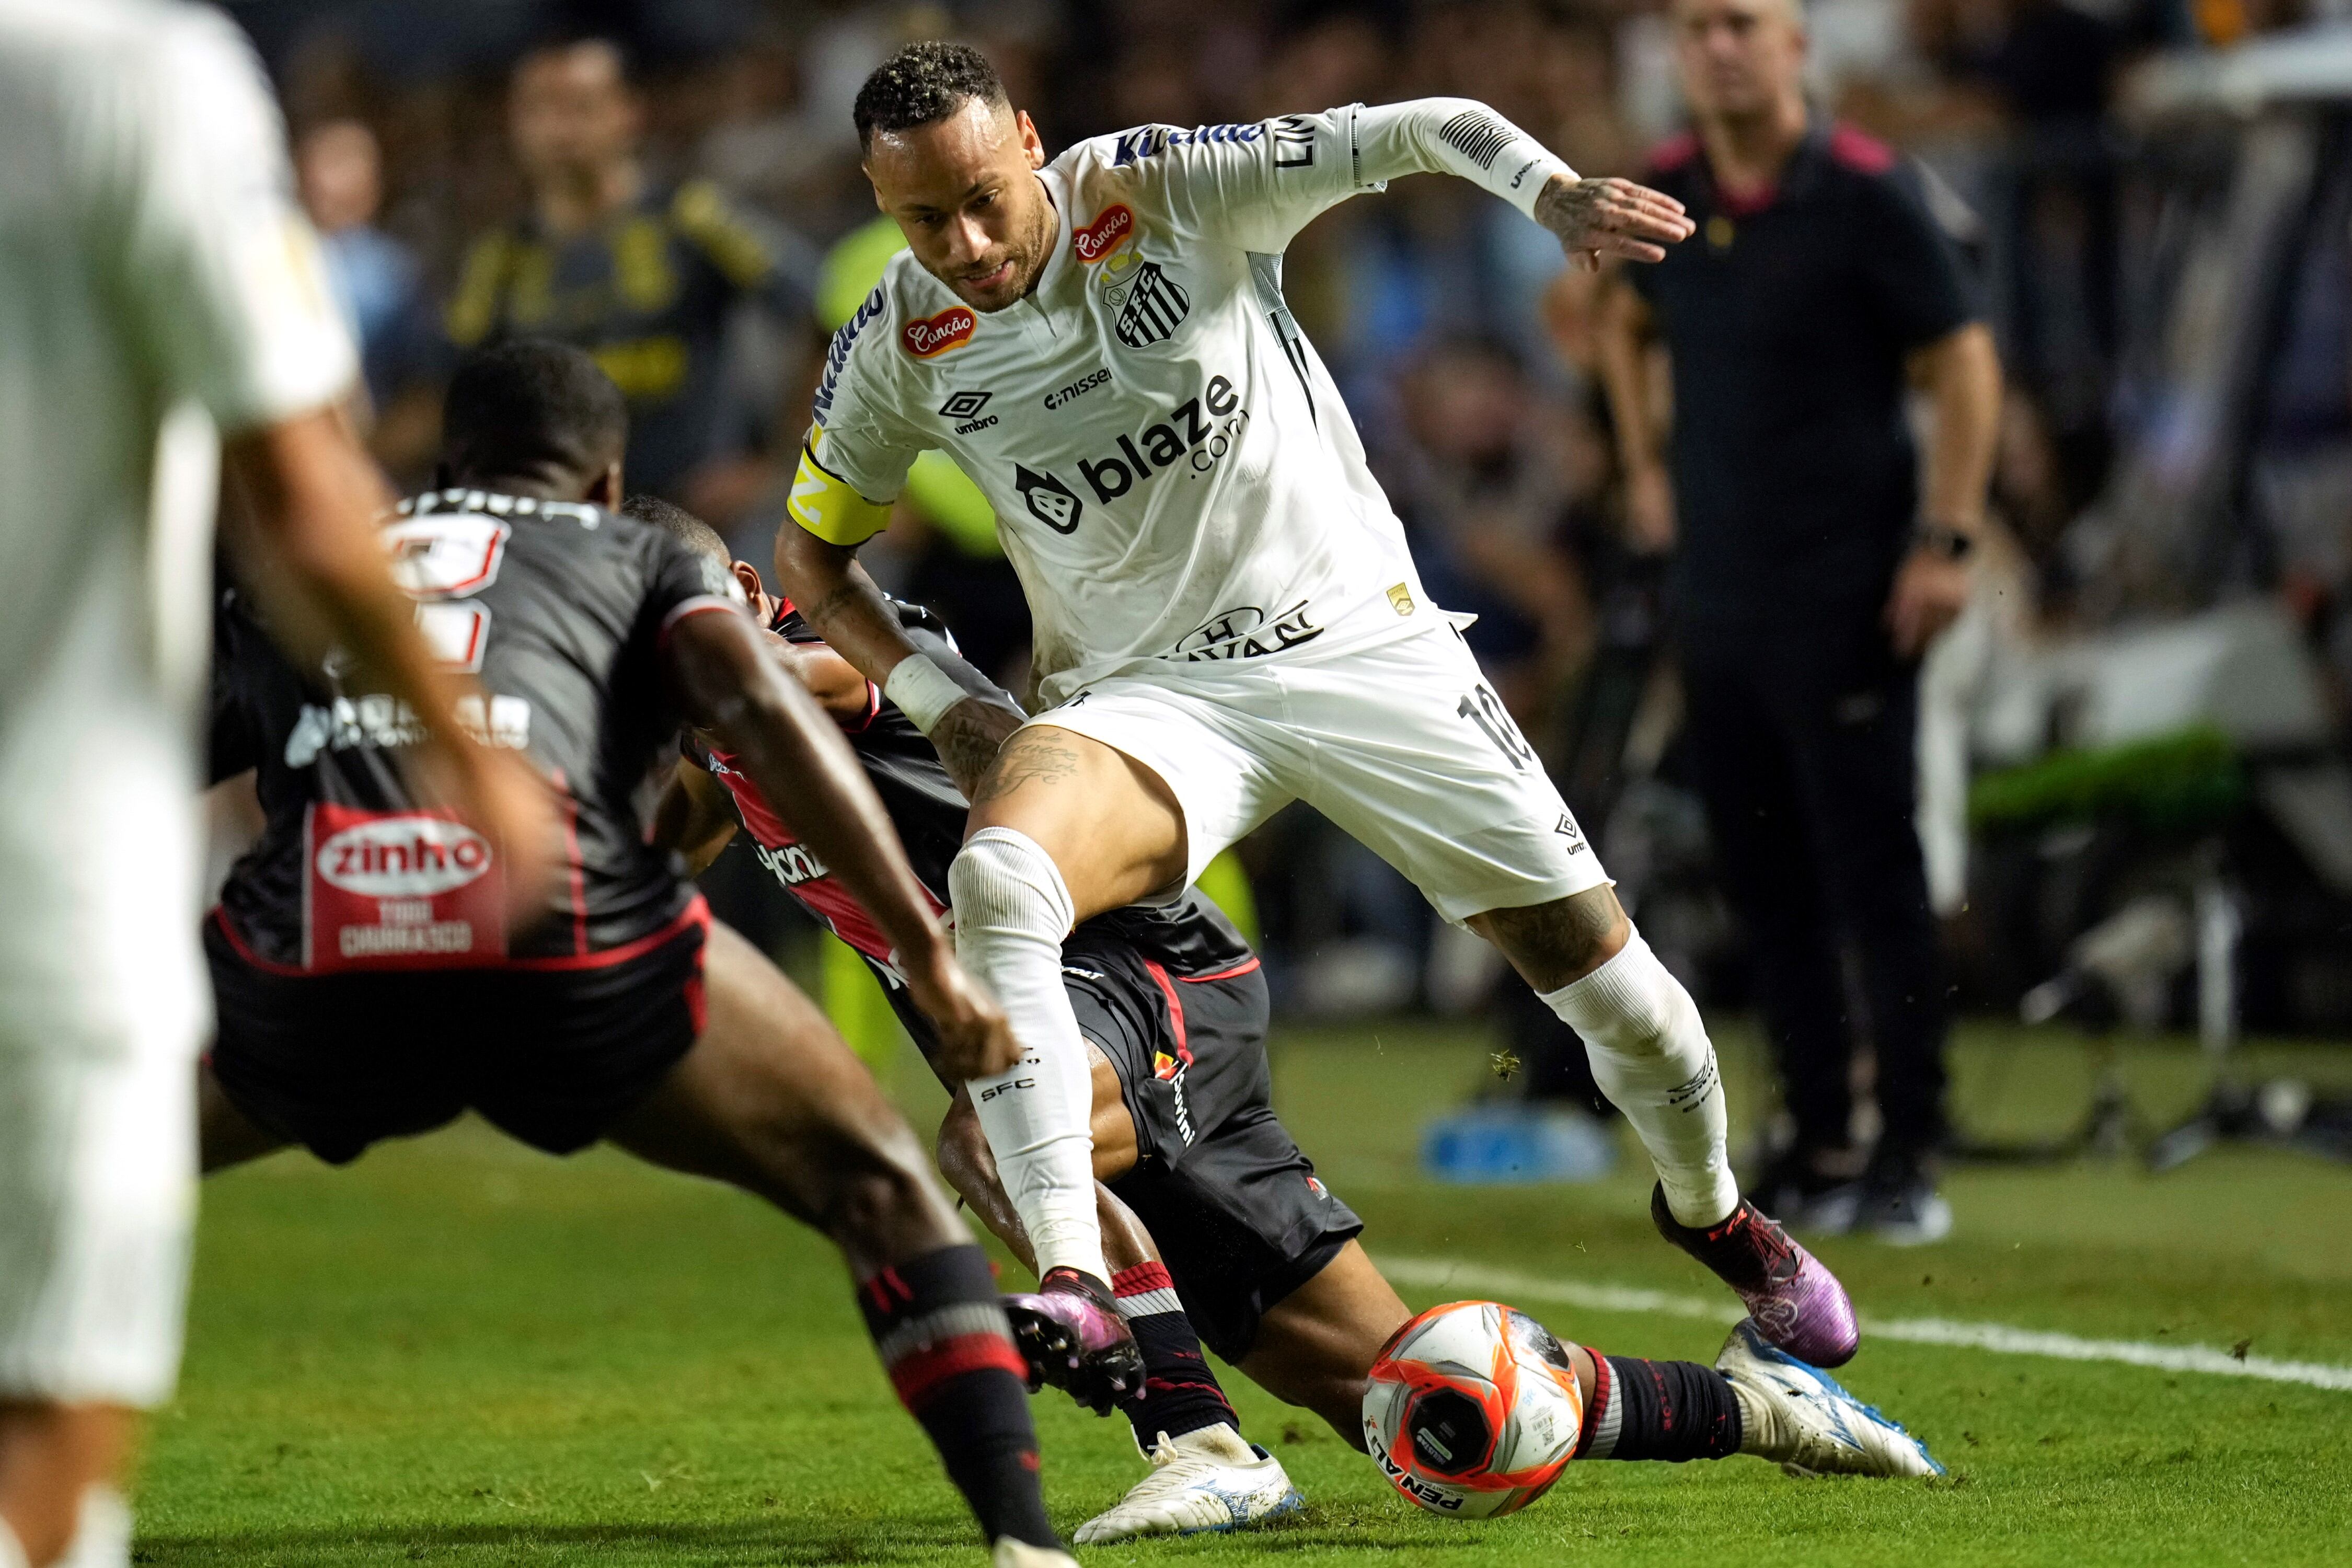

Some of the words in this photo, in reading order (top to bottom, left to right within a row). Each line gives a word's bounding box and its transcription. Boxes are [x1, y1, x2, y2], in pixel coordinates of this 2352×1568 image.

[1074, 212, 1128, 258] Canção
[908, 317, 971, 352] Canção
[954, 414, 999, 435] umbro
[1077, 375, 1239, 505] blaze
[1457, 683, 1532, 770] 10
[333, 835, 485, 874] zinho
[981, 1078, 1036, 1102] SFC
